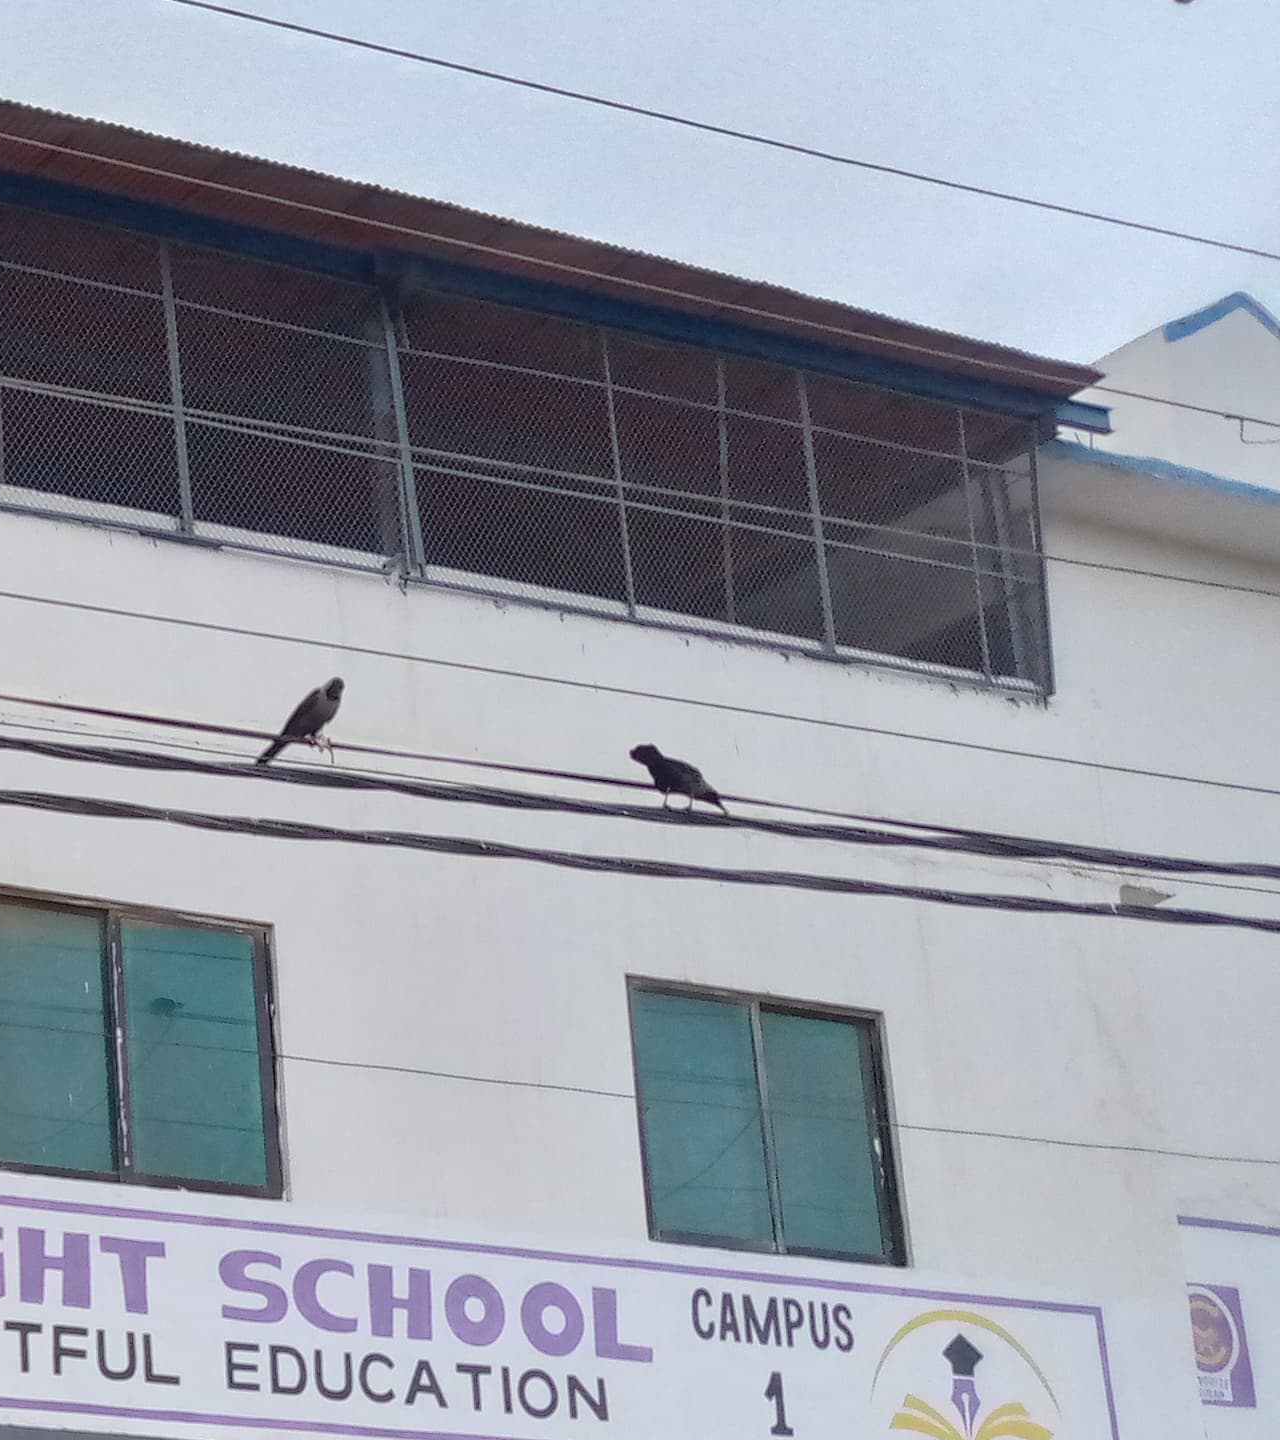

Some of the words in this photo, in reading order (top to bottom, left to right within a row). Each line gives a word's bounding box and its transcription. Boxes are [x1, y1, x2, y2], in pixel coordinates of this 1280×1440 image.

[218, 1249, 654, 1363] SCHOOL
[691, 1287, 855, 1352] CAMPUS
[224, 1341, 610, 1422] EDUCATION
[764, 1371, 794, 1437] 1
